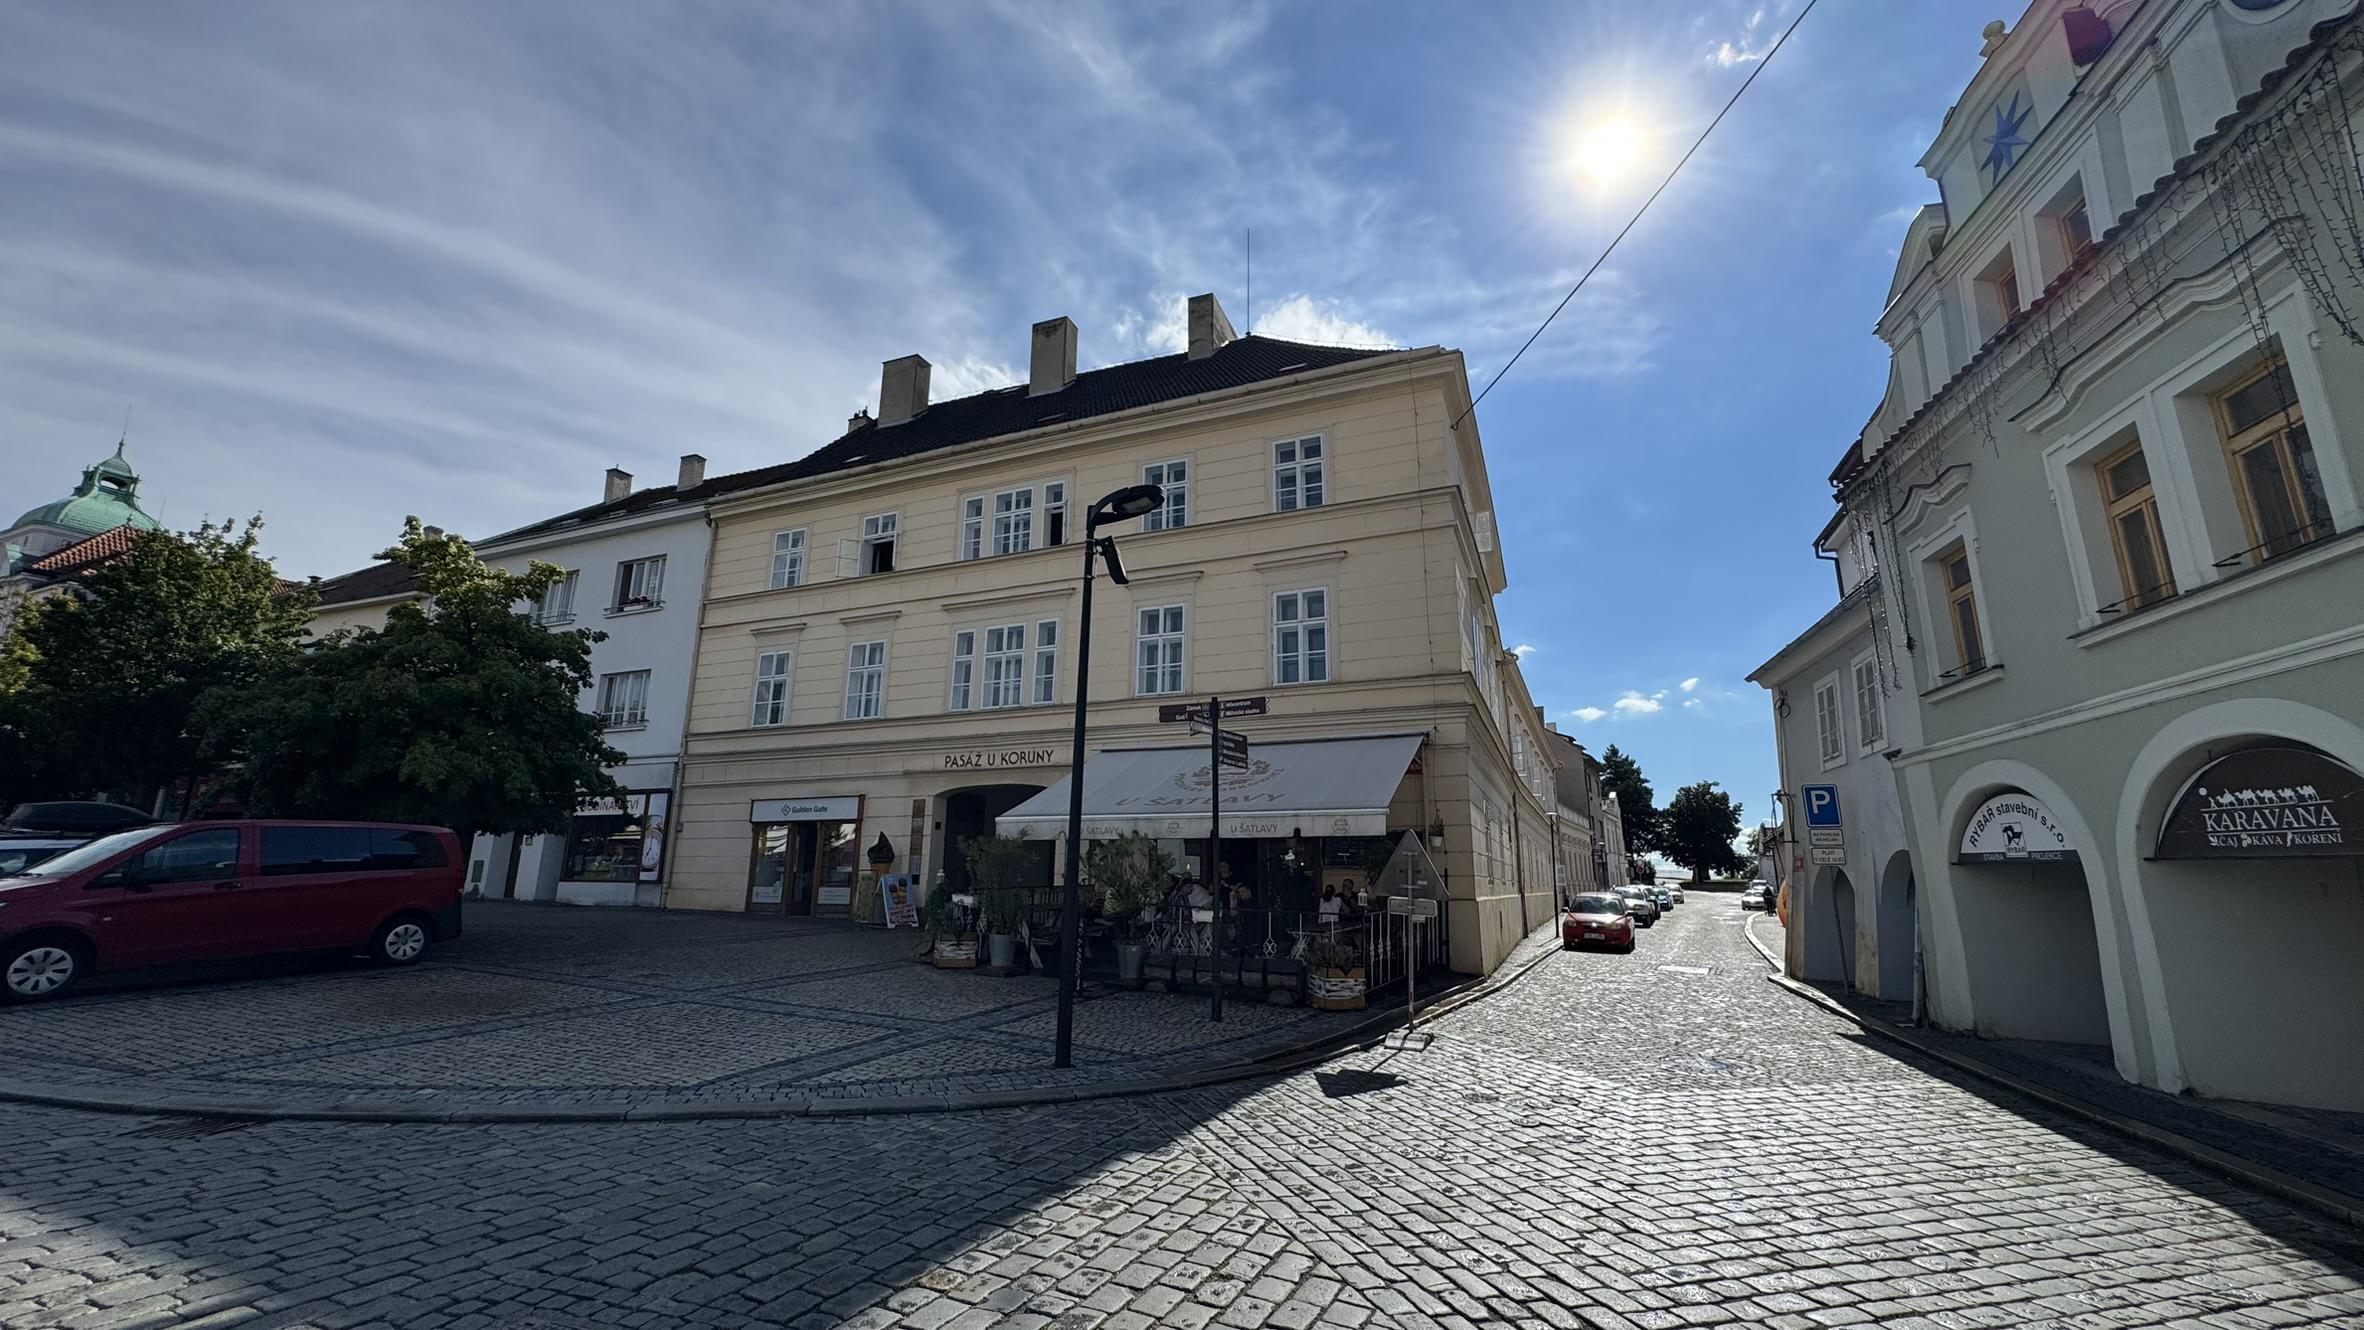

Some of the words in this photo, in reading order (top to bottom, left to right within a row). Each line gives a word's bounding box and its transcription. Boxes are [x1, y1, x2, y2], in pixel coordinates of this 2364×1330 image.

[944, 751, 982, 768] PASÁŽ
[987, 753, 996, 766] U
[1000, 749, 1055, 766] KORUNY
[791, 806, 812, 814] Golden
[813, 805, 828, 813] Gate
[1810, 790, 1831, 814] P
[1230, 823, 1238, 834] U
[1239, 820, 1279, 834] ŠATLAVY
[1969, 805, 1996, 848] RYBÁŘ
[1996, 802, 2040, 820] stavební
[2040, 816, 2066, 848] s.r.o.
[2202, 804, 2340, 832] KARAVANA
[2218, 834, 2239, 848] ČAJ
[2251, 833, 2284, 846] KÁVA
[2295, 831, 2344, 845] KOŘENÍ
